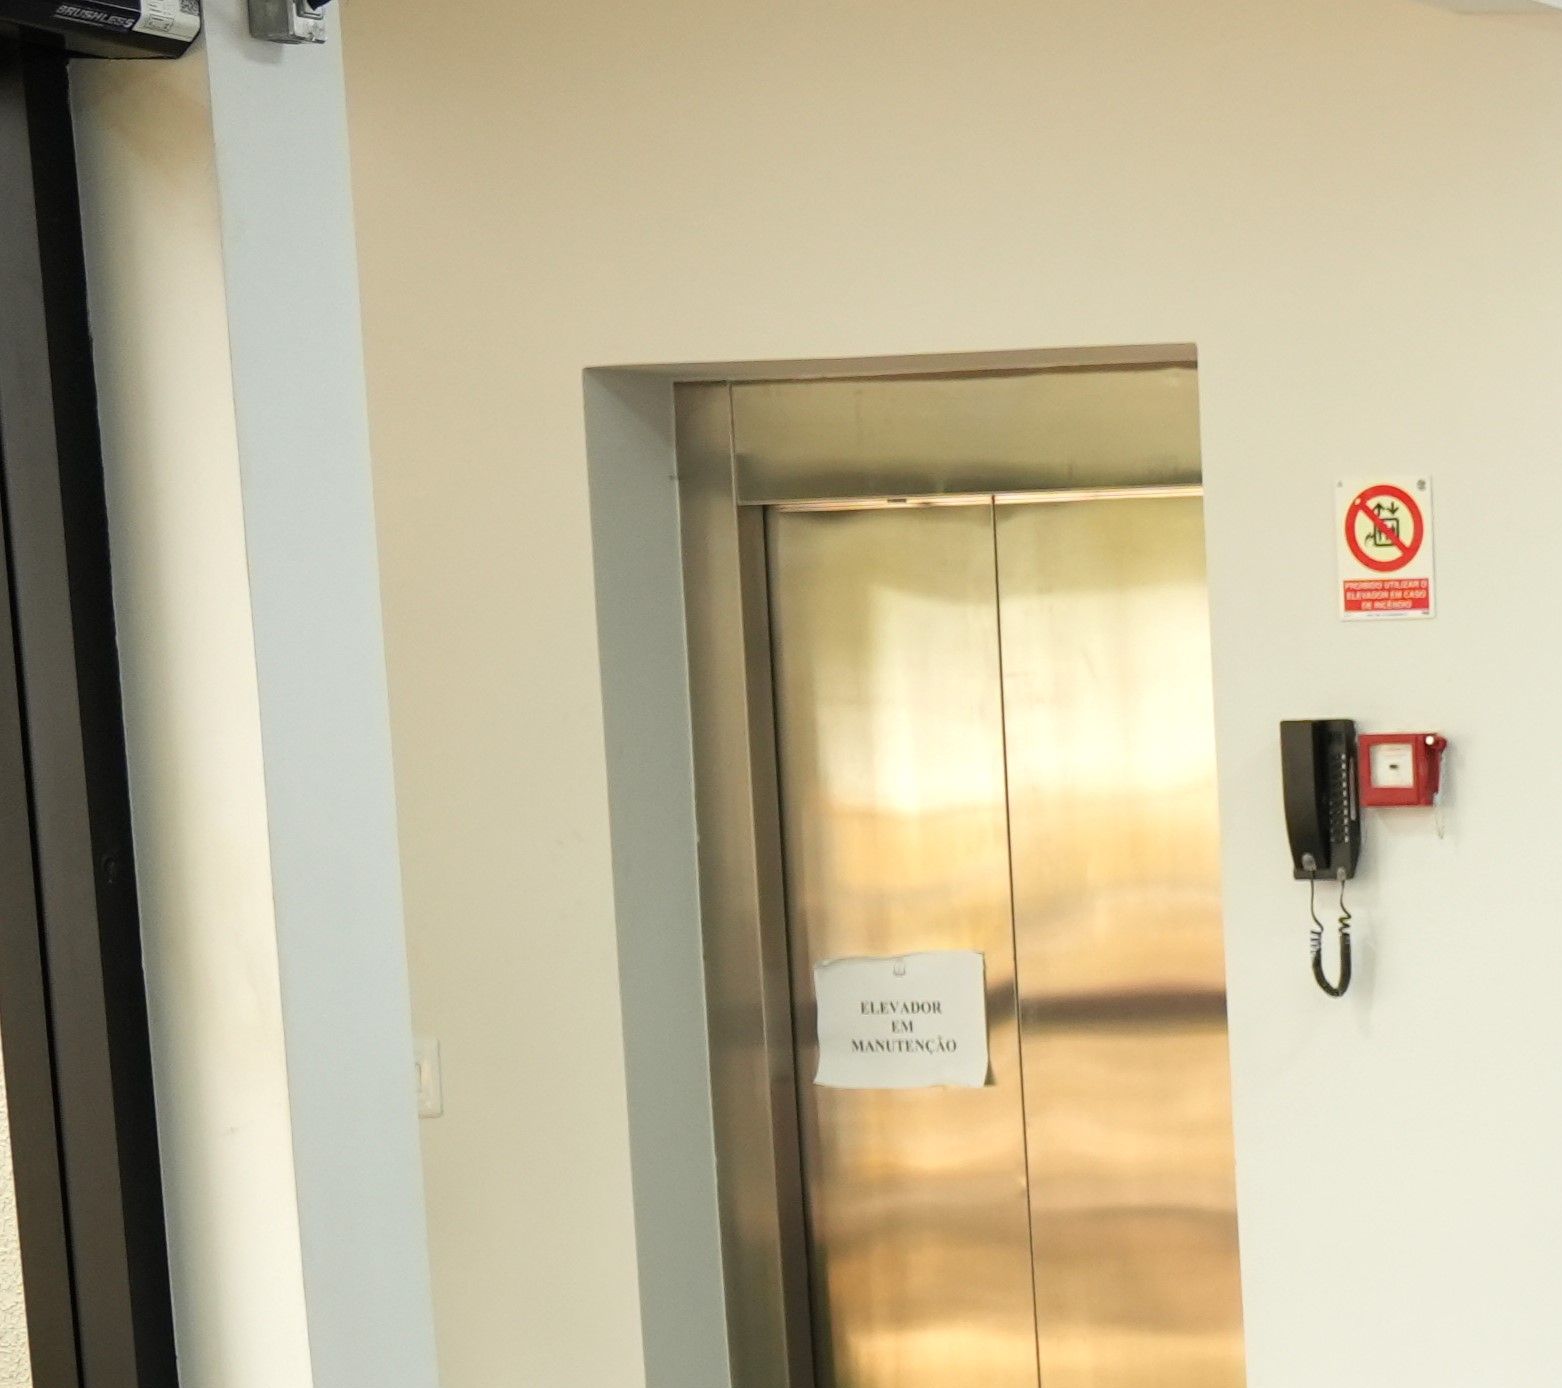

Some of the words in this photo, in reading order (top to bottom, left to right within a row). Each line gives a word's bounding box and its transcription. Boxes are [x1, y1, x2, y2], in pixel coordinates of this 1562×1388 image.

[860, 1001, 942, 1014] ELEVADOR
[891, 1020, 914, 1033] EM
[852, 1035, 957, 1055] MANUTENÇÃO
